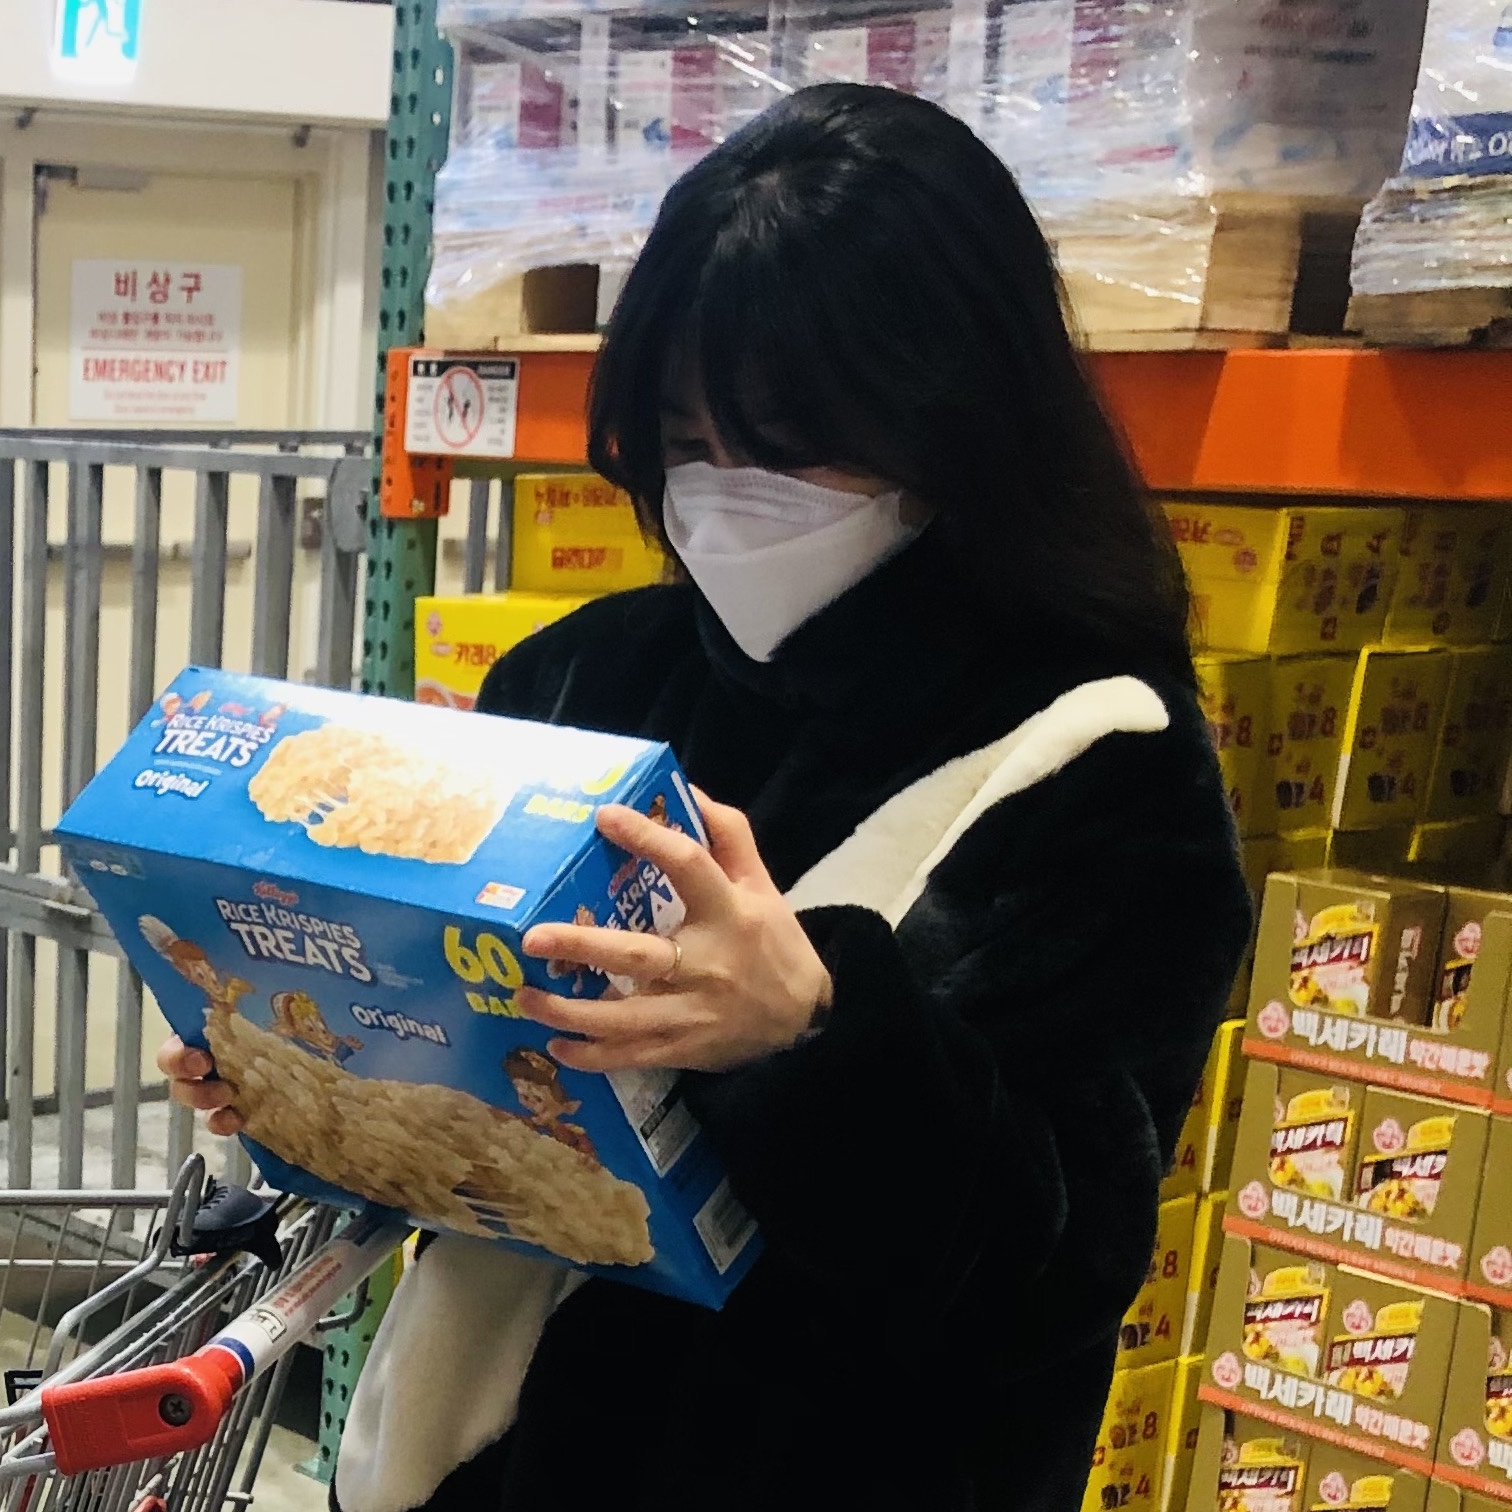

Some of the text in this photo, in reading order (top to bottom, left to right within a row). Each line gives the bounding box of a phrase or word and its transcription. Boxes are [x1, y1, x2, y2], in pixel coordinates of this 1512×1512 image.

[114, 268, 202, 304] 비상구
[82, 357, 228, 384] EMERGENCY EXIT
[154, 728, 260, 768] TREATS
[167, 713, 276, 744] RICE KRISPIES
[216, 898, 362, 950] RICE KRISPIES
[230, 922, 373, 983] TREATS
[443, 924, 525, 990] 60
[351, 1004, 447, 1045] Original
